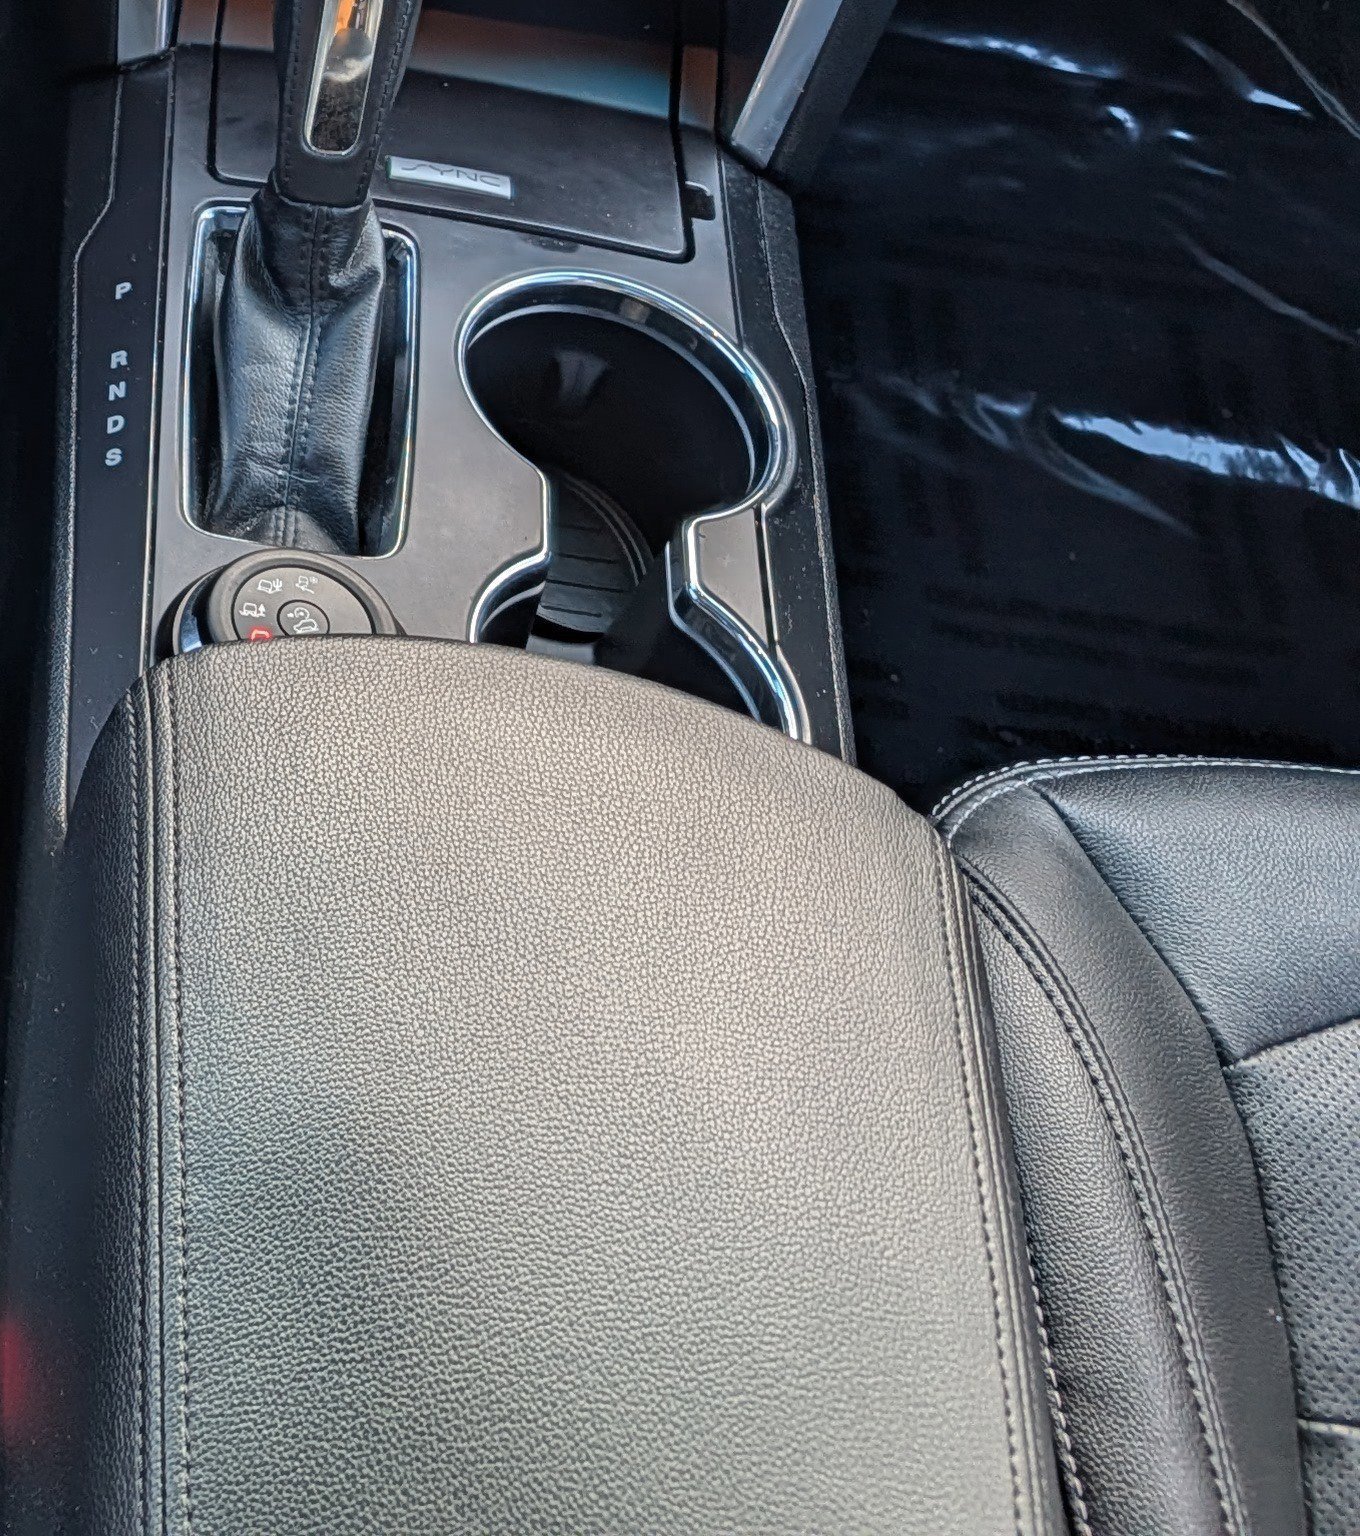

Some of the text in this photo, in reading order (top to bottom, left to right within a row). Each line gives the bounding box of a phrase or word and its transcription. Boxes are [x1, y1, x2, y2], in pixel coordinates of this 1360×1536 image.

[400, 163, 501, 187] SYNC
[114, 282, 132, 300] P
[110, 350, 128, 368] R
[108, 382, 126, 401] N
[106, 415, 125, 434] D
[105, 447, 123, 467] S
